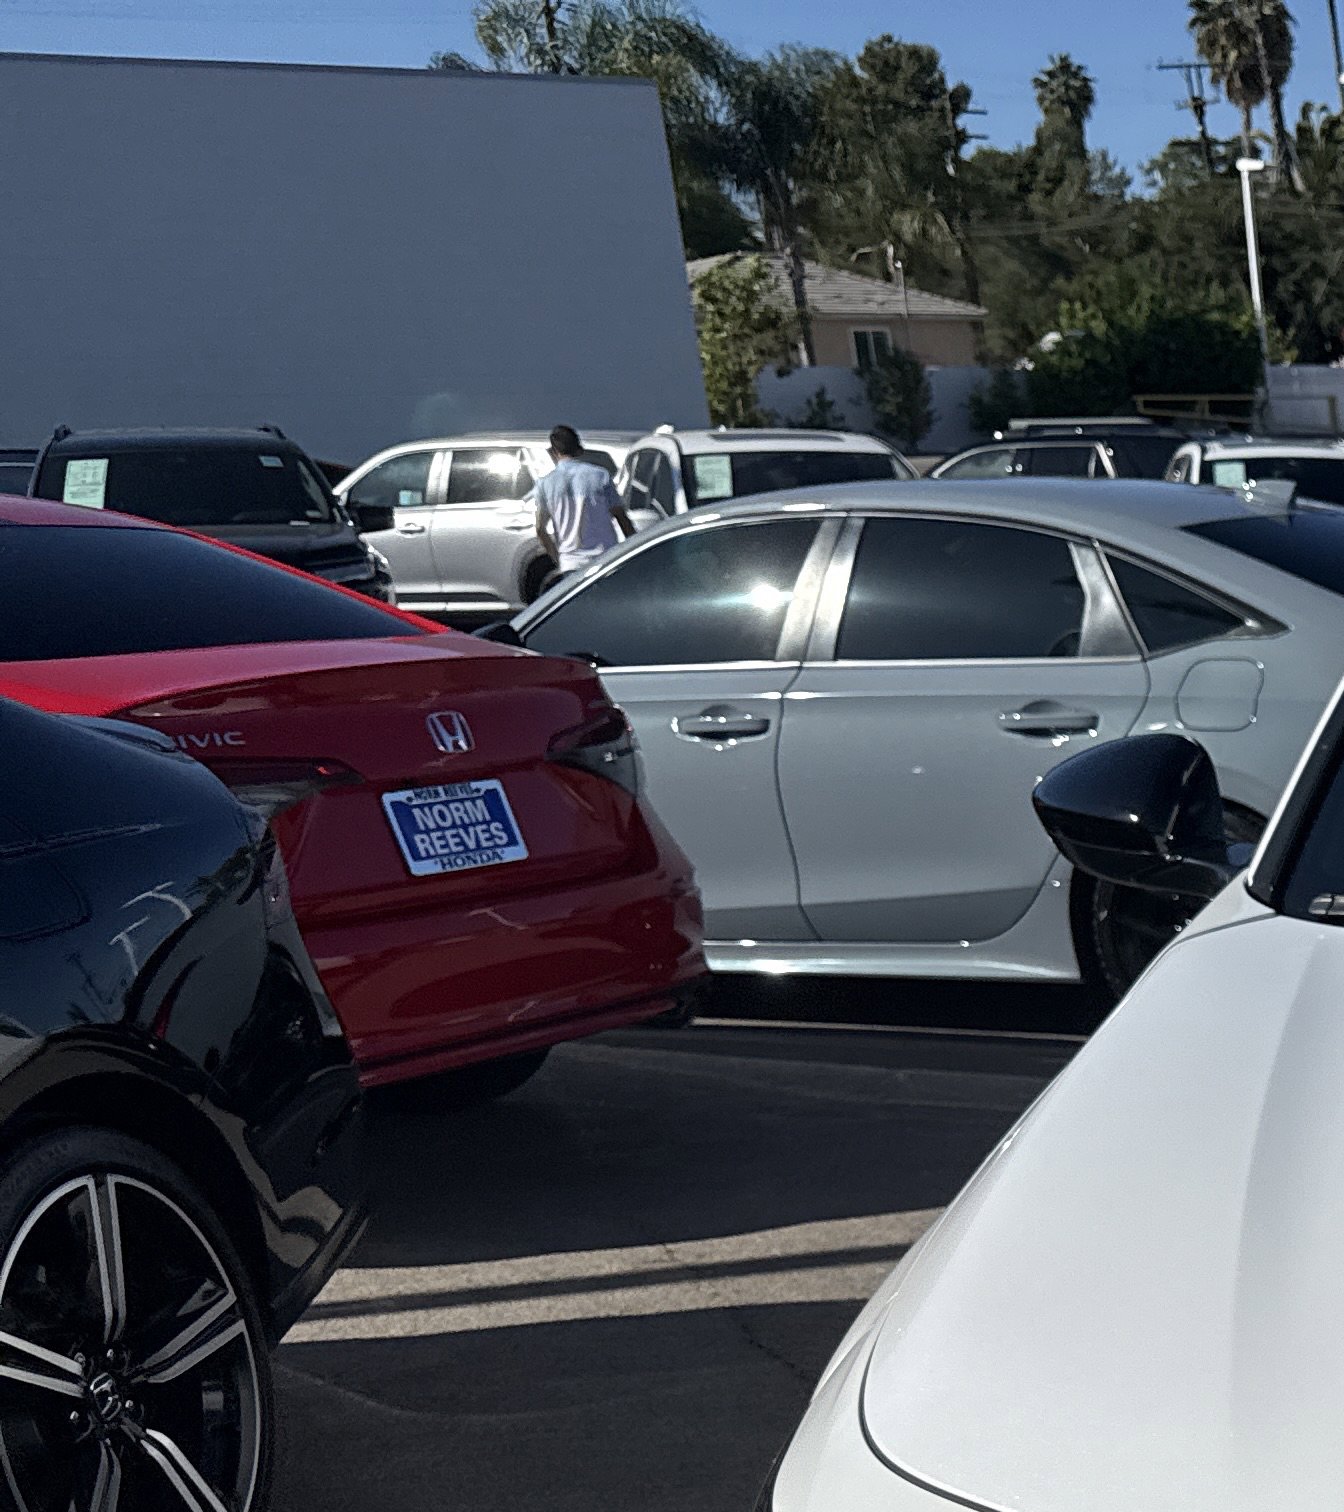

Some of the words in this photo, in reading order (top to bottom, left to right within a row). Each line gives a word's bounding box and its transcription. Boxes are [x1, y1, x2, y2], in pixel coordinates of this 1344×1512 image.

[171, 731, 246, 748] IVIC
[412, 798, 491, 831] NORM
[414, 822, 509, 858] REEVES
[440, 850, 504, 870] HONDA
